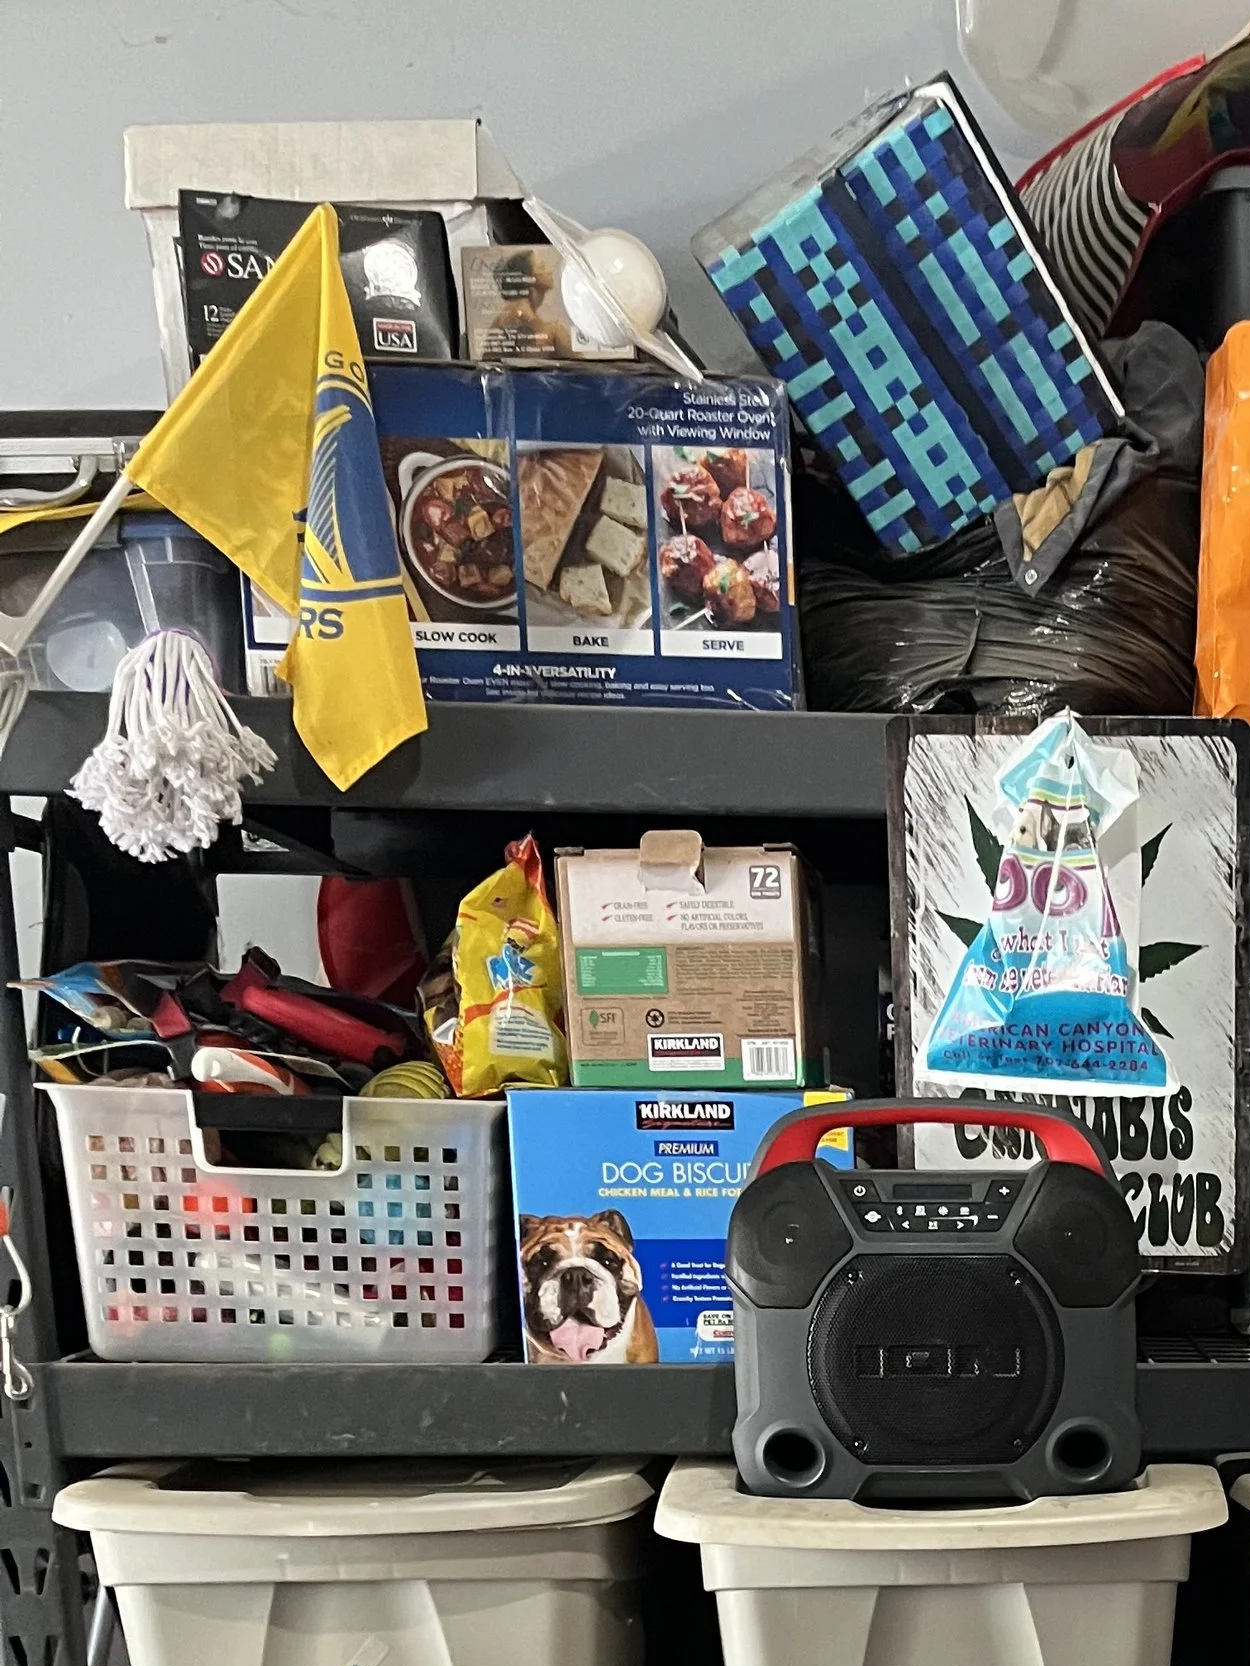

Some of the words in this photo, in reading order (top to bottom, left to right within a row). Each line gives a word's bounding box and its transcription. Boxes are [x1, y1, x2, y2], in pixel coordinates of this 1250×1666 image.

[377, 330, 415, 349] USA
[682, 391, 737, 406] Stainless
[627, 406, 684, 422] 20-Quart
[687, 408, 735, 423] Roaster
[737, 410, 772, 425] Oven
[637, 425, 665, 437] with
[666, 424, 717, 441] Viewing
[718, 427, 772, 440] Window
[415, 630, 456, 643] SLOW
[458, 632, 498, 644] COOK
[572, 635, 609, 648] BAKE
[702, 639, 745, 651] SERVE
[531, 665, 617, 679] VERSATILITY
[750, 867, 780, 889] 72
[1058, 1022, 1145, 1038] CANYON
[653, 1037, 719, 1050] KIRKLAND
[1062, 1039, 1159, 1057] HOSPITAL
[639, 1102, 731, 1119] KIRKLAND
[658, 1143, 715, 1155] PREMIUM
[602, 1162, 664, 1183] DOG
[673, 1163, 751, 1184] BISCUI
[598, 1188, 648, 1197] CHICKEN
[651, 1188, 680, 1197] MEAL
[682, 1188, 692, 1198] &
[695, 1188, 718, 1198] RICE
